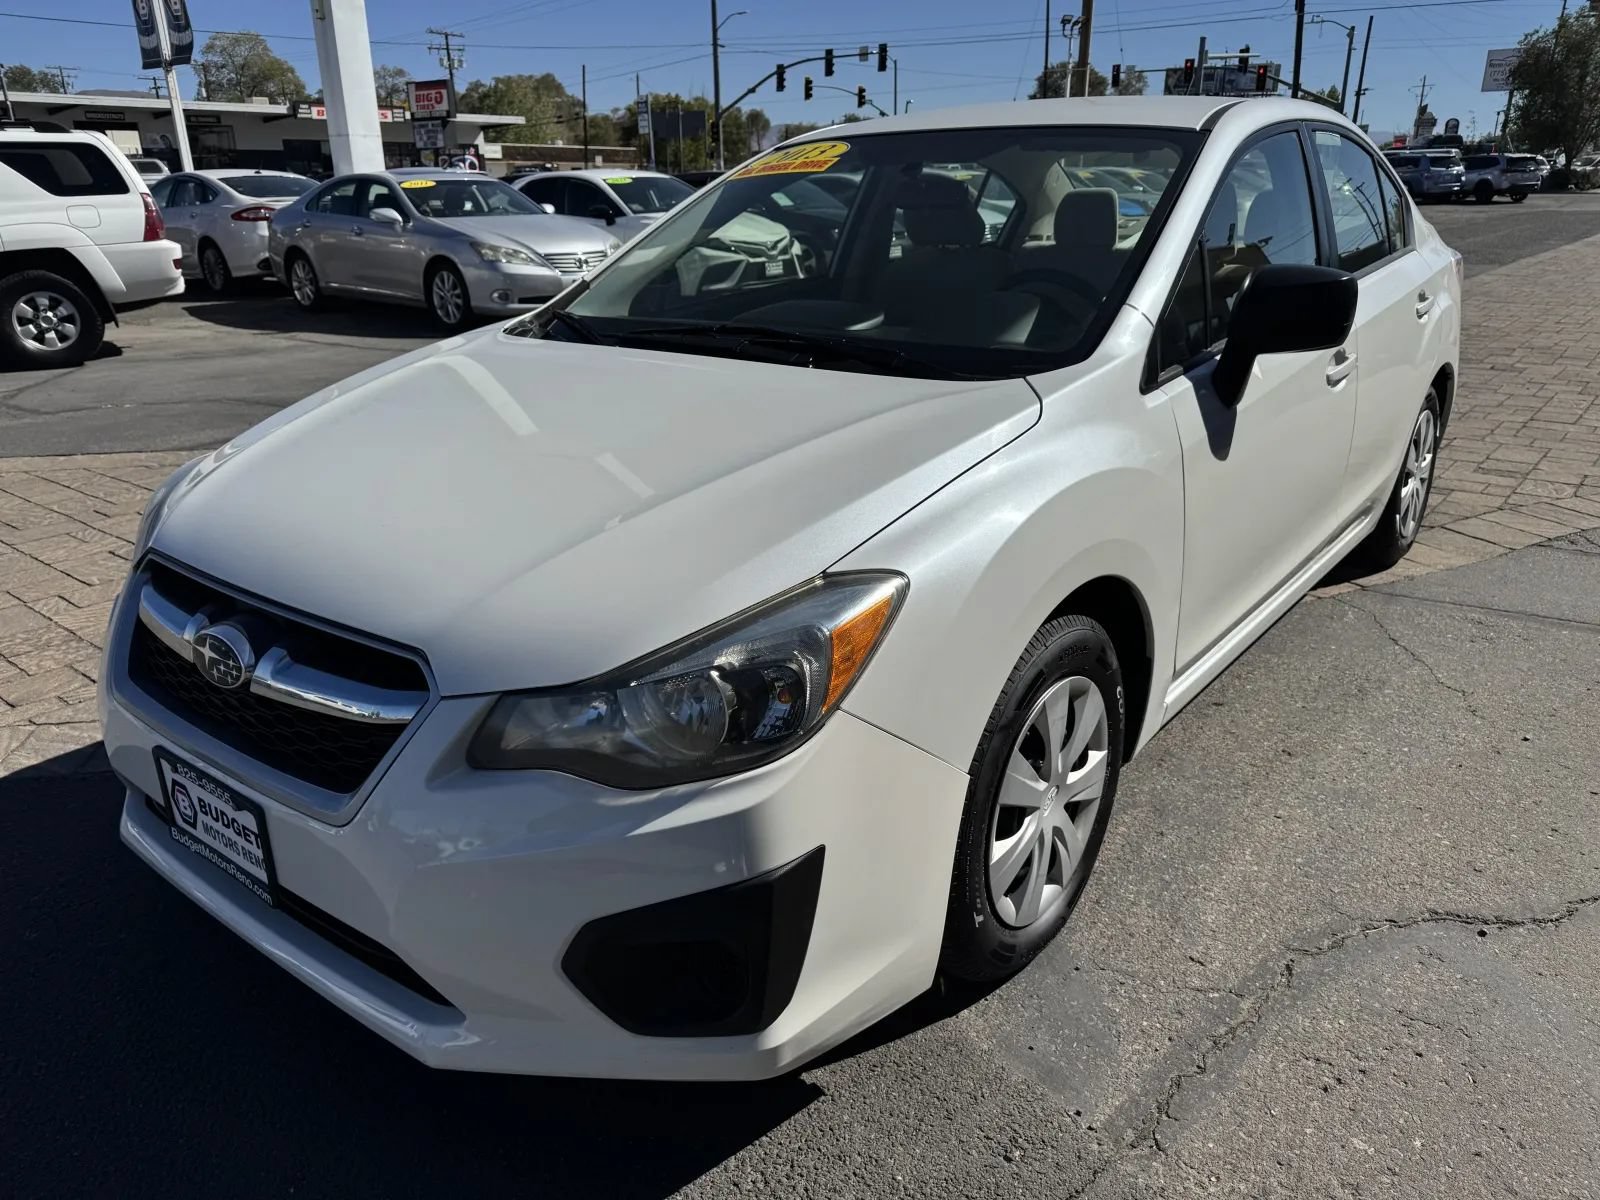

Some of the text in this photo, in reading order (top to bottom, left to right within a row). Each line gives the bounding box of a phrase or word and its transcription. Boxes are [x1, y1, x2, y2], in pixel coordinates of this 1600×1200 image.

[416, 93, 432, 104] BIG
[791, 159, 835, 172] DRIVE
[197, 796, 261, 850] BUDGET
[201, 820, 241, 857] MOTORS
[171, 826, 273, 906] BudgetMotorsReno.com
